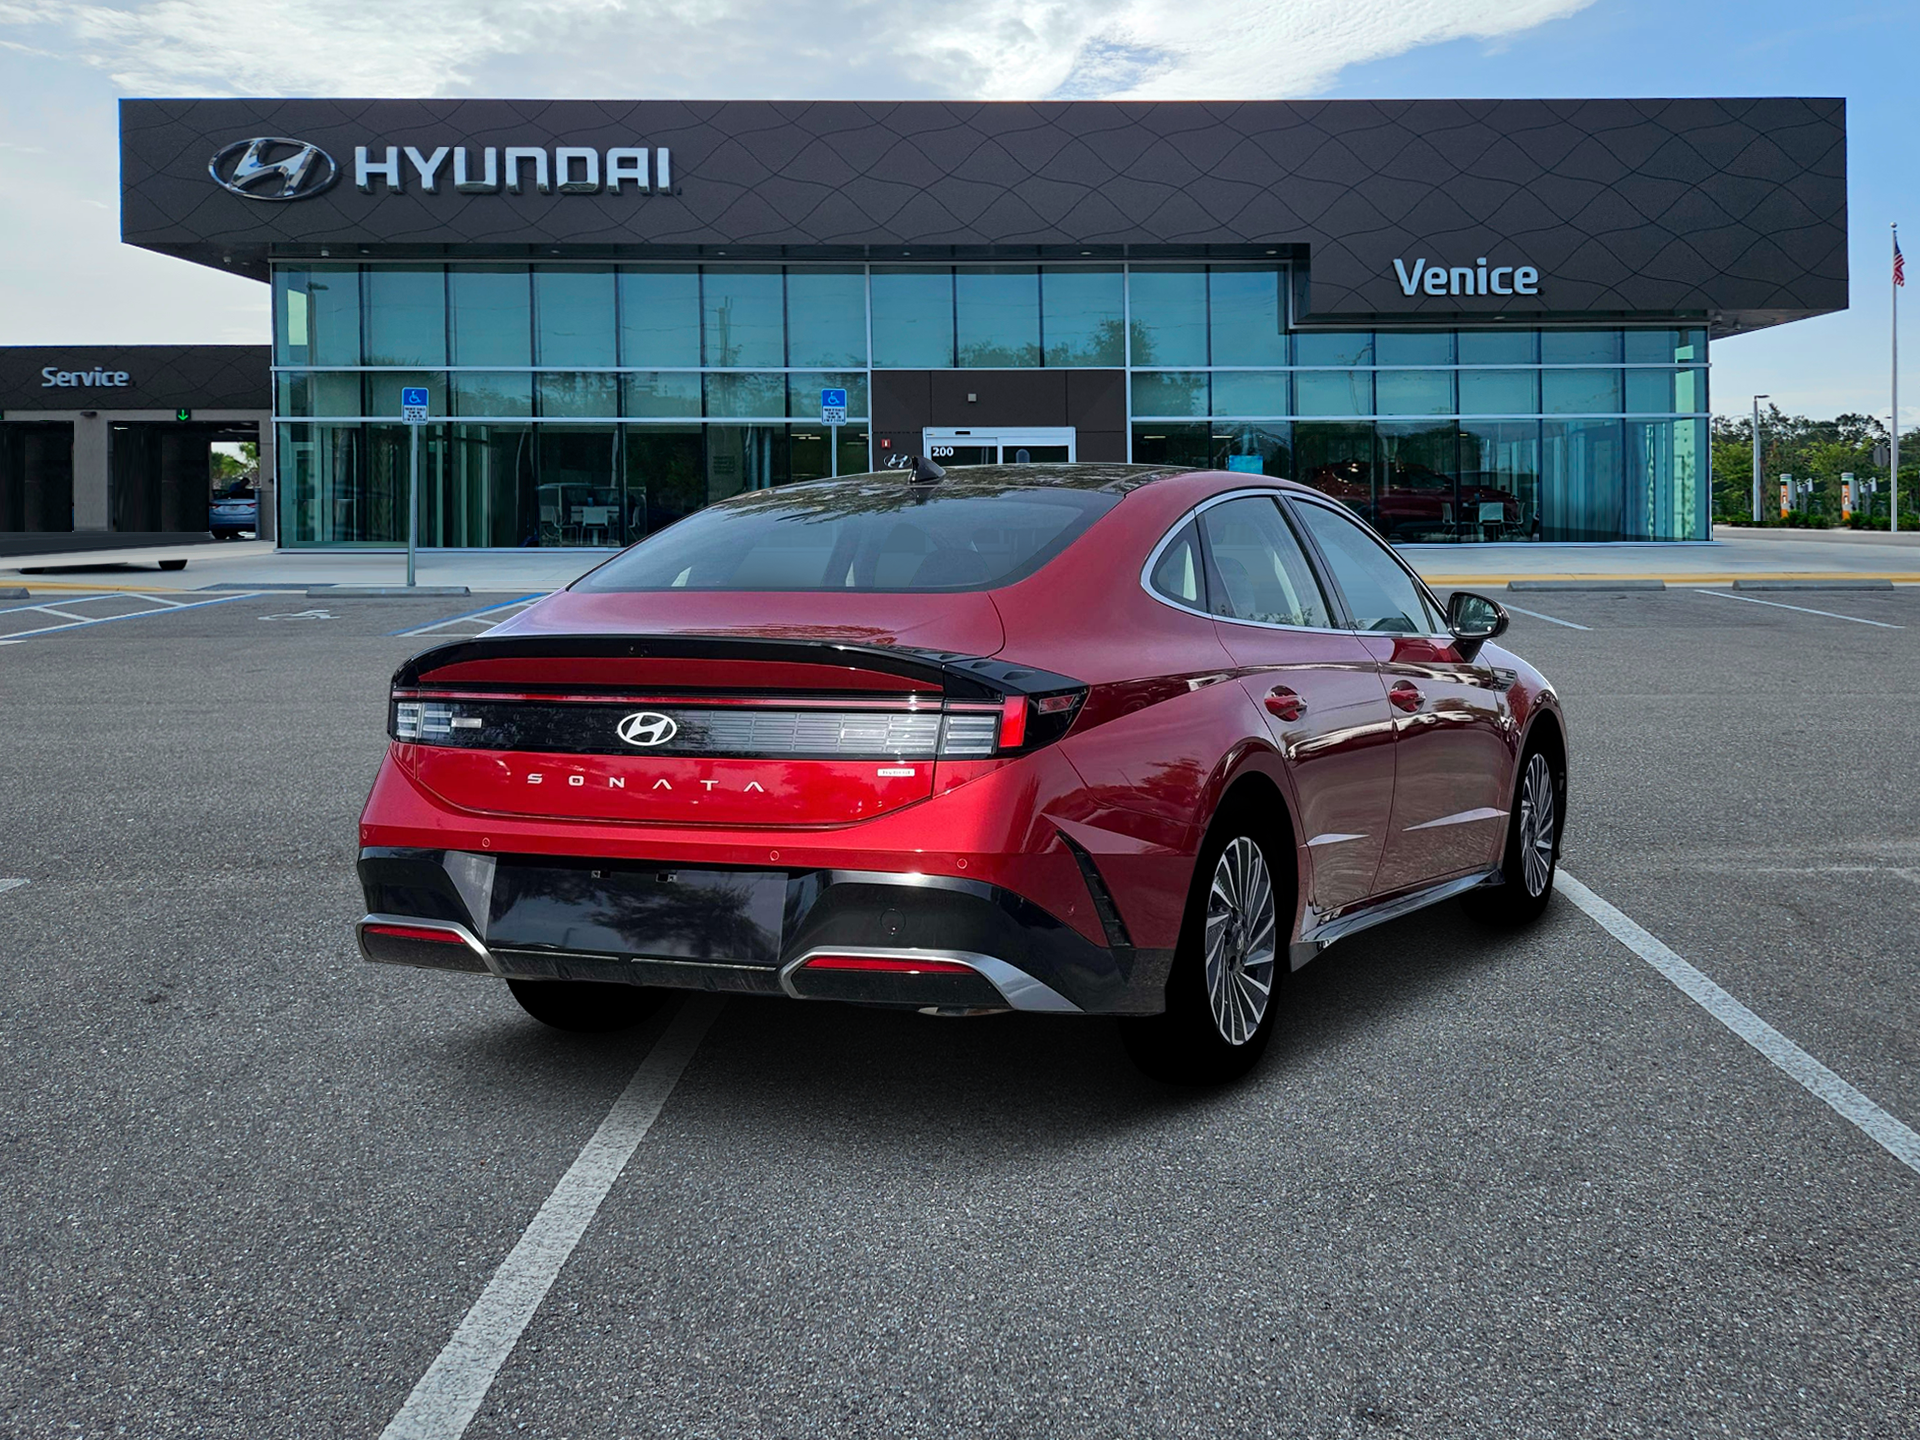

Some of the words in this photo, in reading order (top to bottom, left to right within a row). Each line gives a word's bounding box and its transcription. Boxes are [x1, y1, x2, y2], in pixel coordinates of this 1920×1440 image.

[354, 146, 671, 195] HYUNDAI
[1393, 257, 1539, 296] Venice
[41, 366, 130, 387] Service
[932, 446, 954, 457] 200
[527, 773, 764, 793] SONATA
